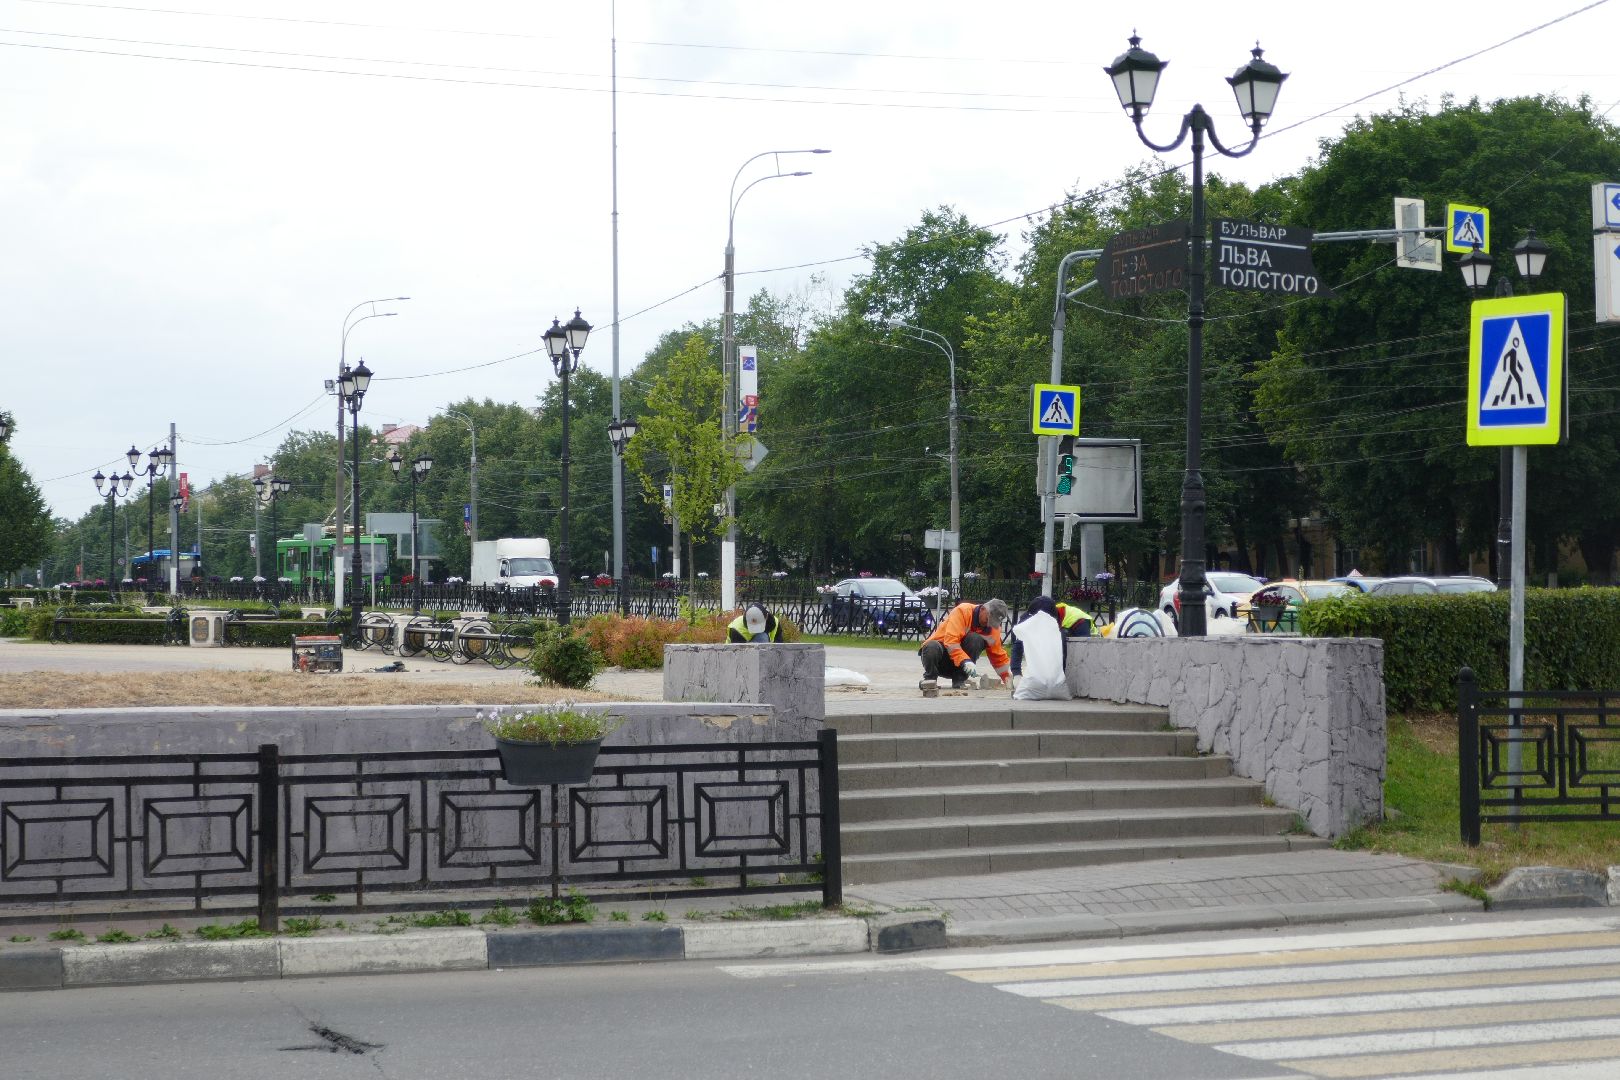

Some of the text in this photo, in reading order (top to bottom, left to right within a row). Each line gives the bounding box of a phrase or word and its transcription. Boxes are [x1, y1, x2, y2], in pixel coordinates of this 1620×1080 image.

[1221, 221, 1287, 240] БУЛЬВАР
[1219, 244, 1273, 267] ЛЬВА
[1219, 266, 1319, 294] ТОЛСТОГО
